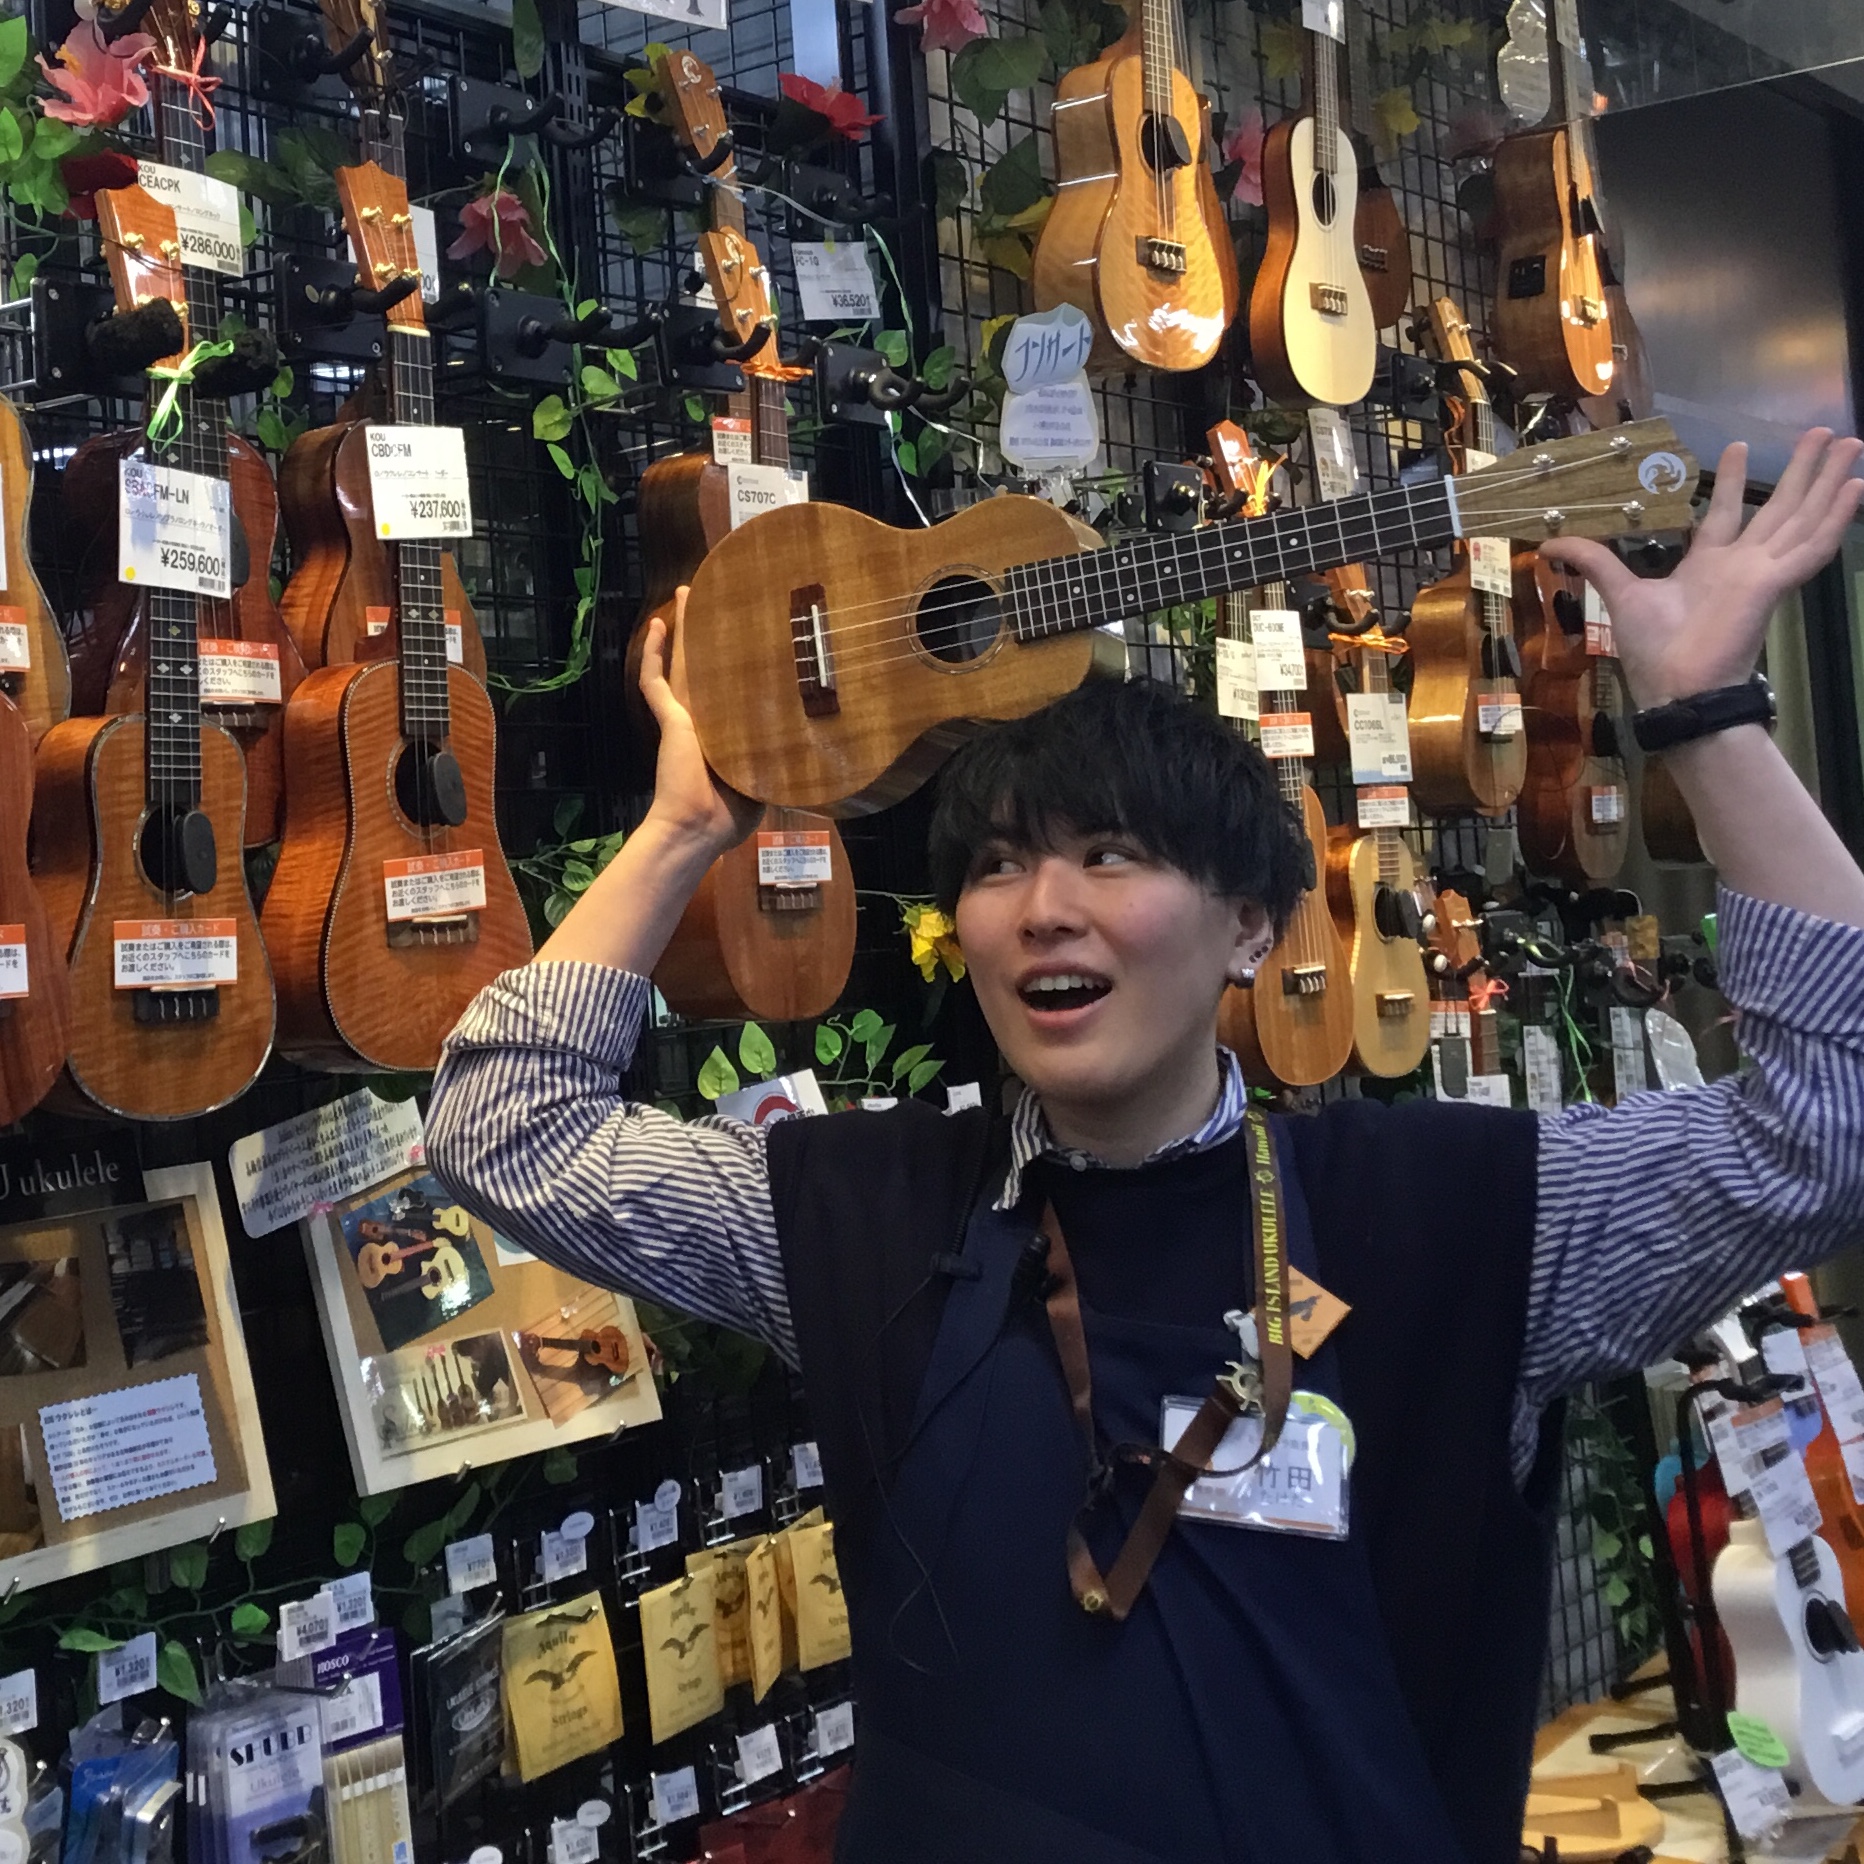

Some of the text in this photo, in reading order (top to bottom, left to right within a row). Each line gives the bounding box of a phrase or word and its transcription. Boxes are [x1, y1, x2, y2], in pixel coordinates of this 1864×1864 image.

[139, 165, 156, 175] KOU
[139, 174, 181, 193] CEACPK
[181, 233, 236, 261] ¥286,000
[831, 294, 867, 308] ¥36,520
[370, 433, 386, 441] KOU
[409, 500, 461, 519] ¥237,600
[737, 489, 777, 505] CS707C
[161, 547, 220, 577] ¥259,600
[19, 1150, 120, 1196] ukulele
[1259, 1188, 1279, 1254] UKULELE
[1264, 1257, 1282, 1313] ISLAND
[1267, 1316, 1284, 1345] BIG
[1254, 1465, 1312, 1491] 竹田
[230, 1724, 313, 1767] SHUBB
